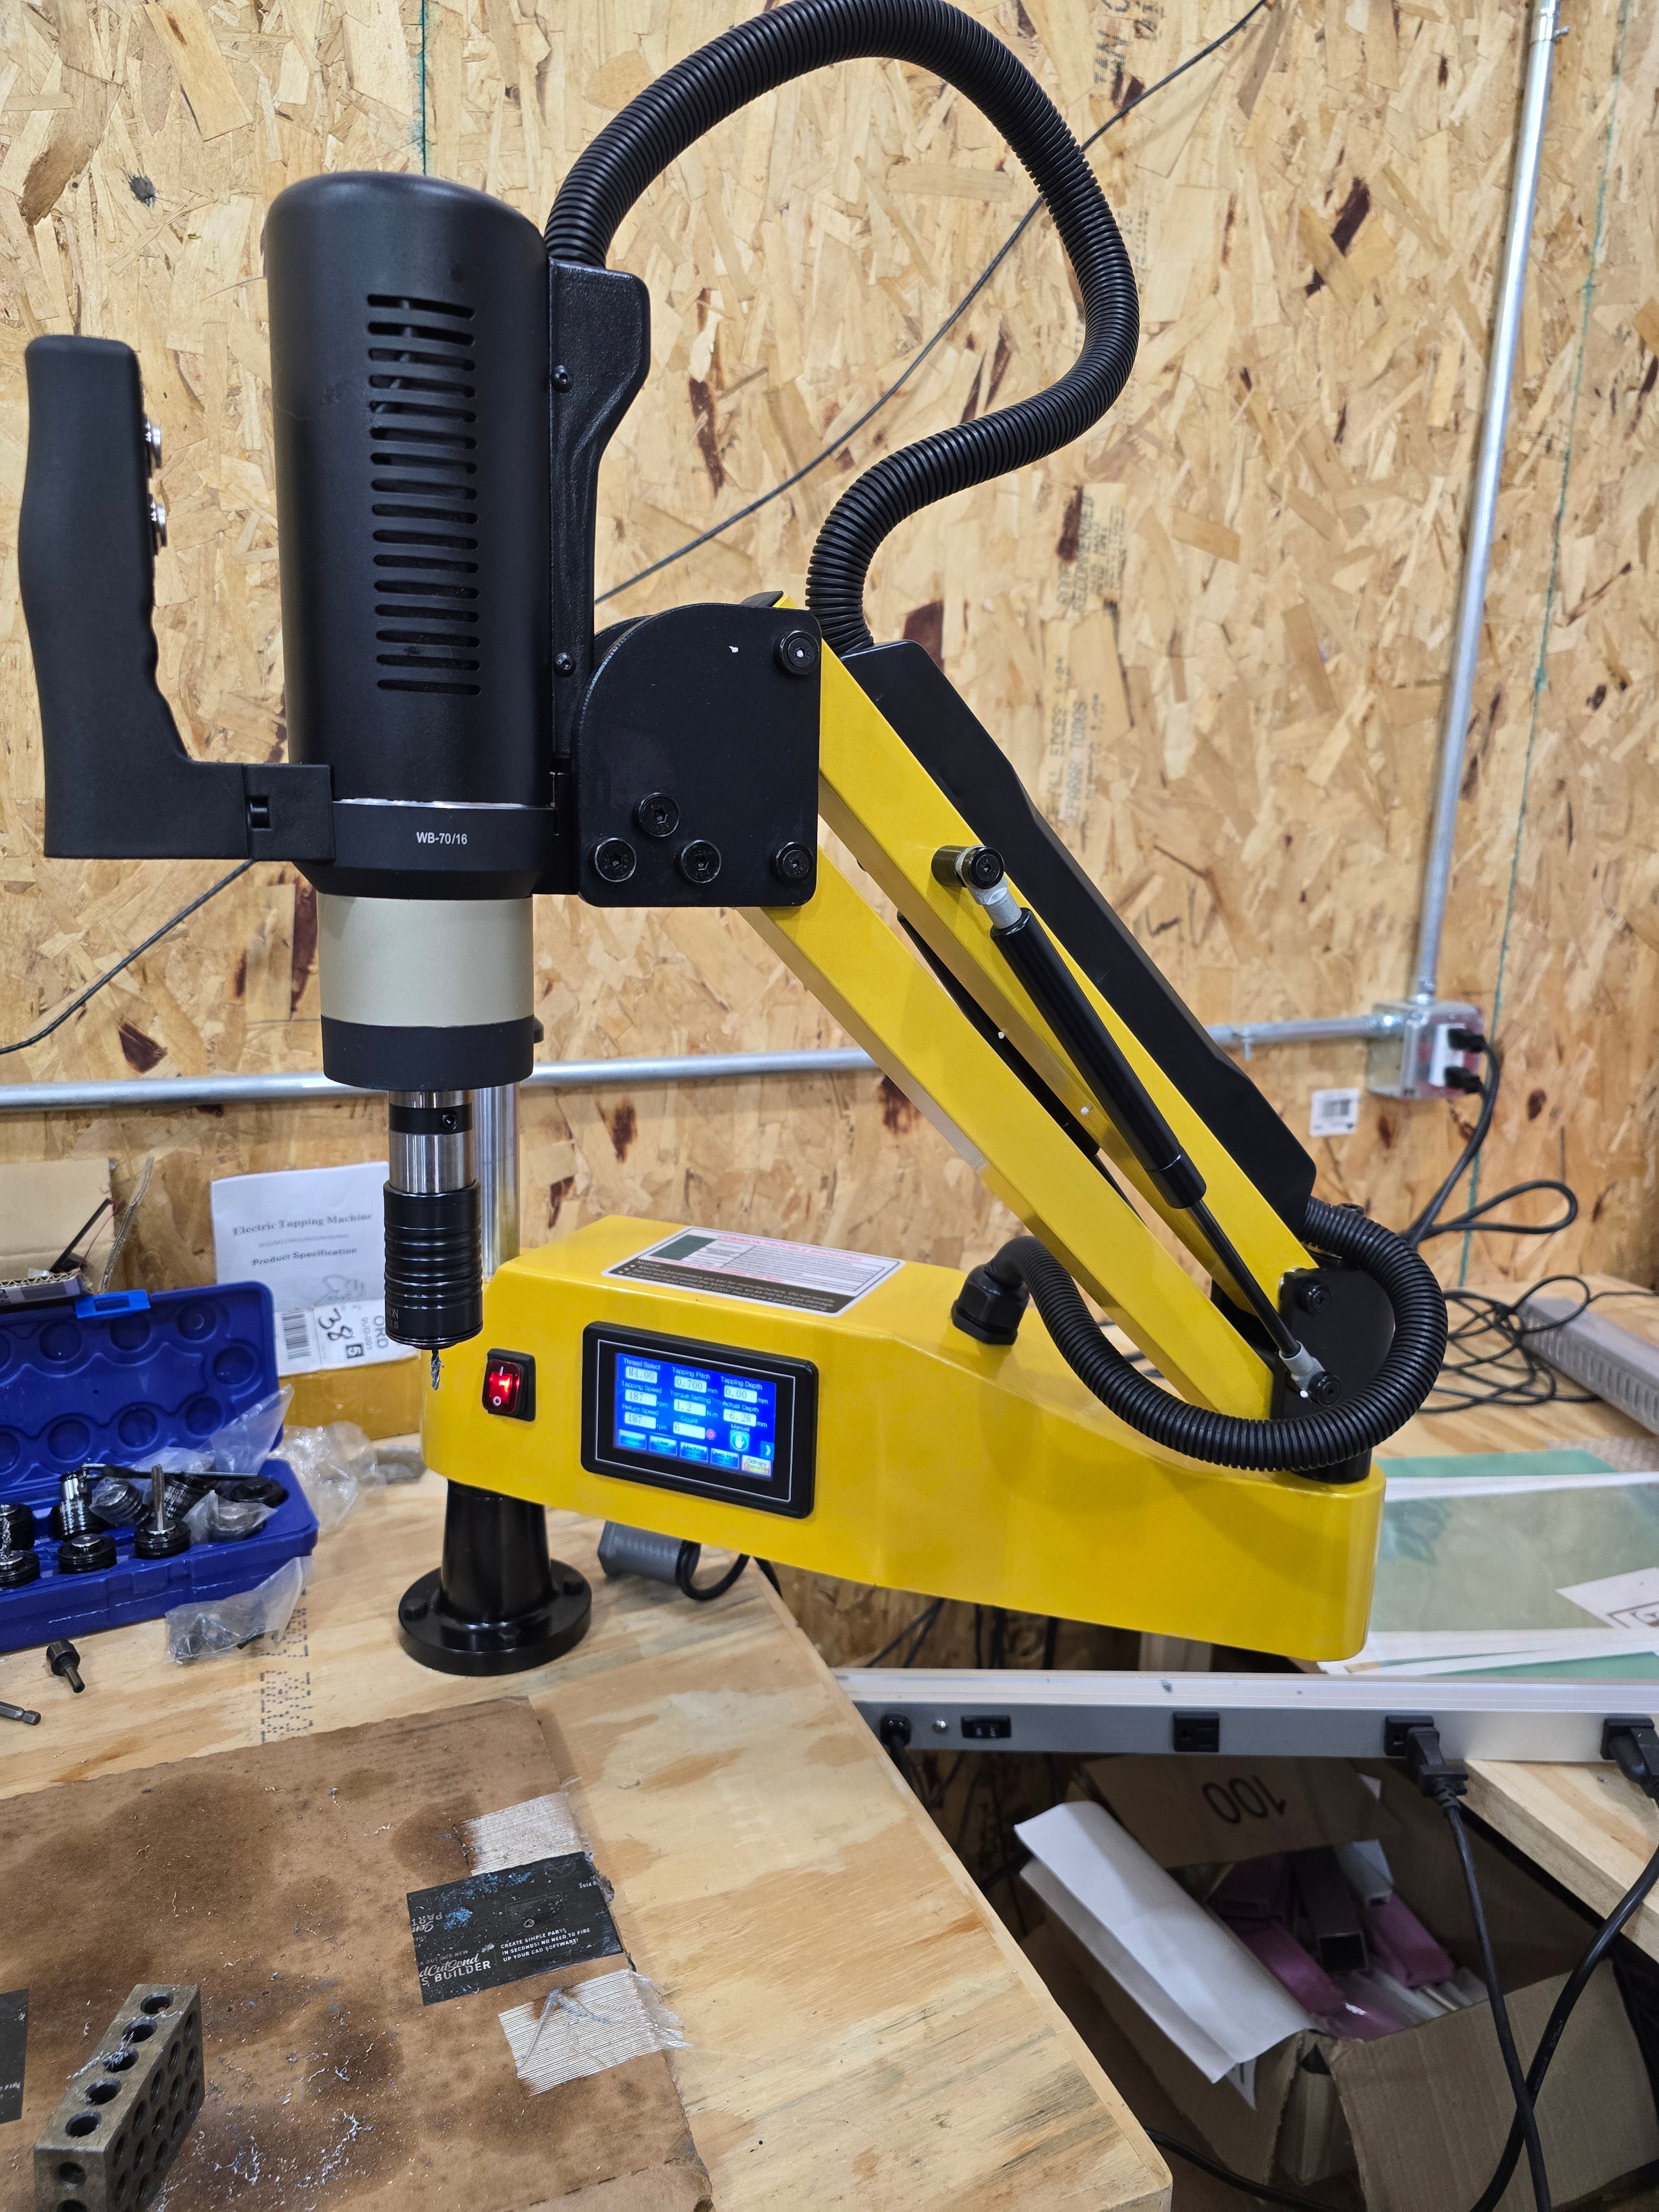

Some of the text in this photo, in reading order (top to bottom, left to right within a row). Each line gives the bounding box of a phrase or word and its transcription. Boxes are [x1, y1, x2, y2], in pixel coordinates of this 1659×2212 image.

[416, 832, 467, 844] WB-70/16
[233, 1213, 372, 1236] Electric Tapping Machine
[761, 1241, 808, 1251] TROUBLE
[808, 1249, 863, 1260] SHOOTING
[252, 1248, 357, 1266] Product Specification
[318, 1307, 354, 1341] 38
[374, 1315, 388, 1348] ORD
[348, 1346, 362, 1355] 5
[623, 1358, 661, 1370] Thread Select
[628, 1368, 654, 1380] M4.00
[672, 1367, 710, 1380] Tapping Pitch
[622, 1380, 661, 1394] Tapping Speed
[677, 1378, 703, 1390] 0.700
[721, 1376, 762, 1390] Tapping Depth
[629, 1391, 644, 1401] 187
[670, 1390, 711, 1404] Torque Setting
[726, 1387, 747, 1399] 0.00
[623, 1404, 659, 1416] Return Speed
[677, 1401, 692, 1412] 1.2
[722, 1401, 759, 1413] Actual Depth
[628, 1414, 643, 1424] 187
[681, 1415, 698, 1424] Count
[725, 1411, 752, 1423] -6.28
[731, 1423, 750, 1432] Manual
[1202, 1775, 1286, 1824] 100
[500, 1928, 567, 1949] CREATE SIMPLE PARTS
[510, 1941, 540, 1954] SECONDS!
[551, 1934, 567, 1942] NEED
[513, 1951, 530, 1959] YOUR
[545, 1938, 578, 1952] SOFTWARE!
[421, 1960, 491, 1986] S BUILDER
